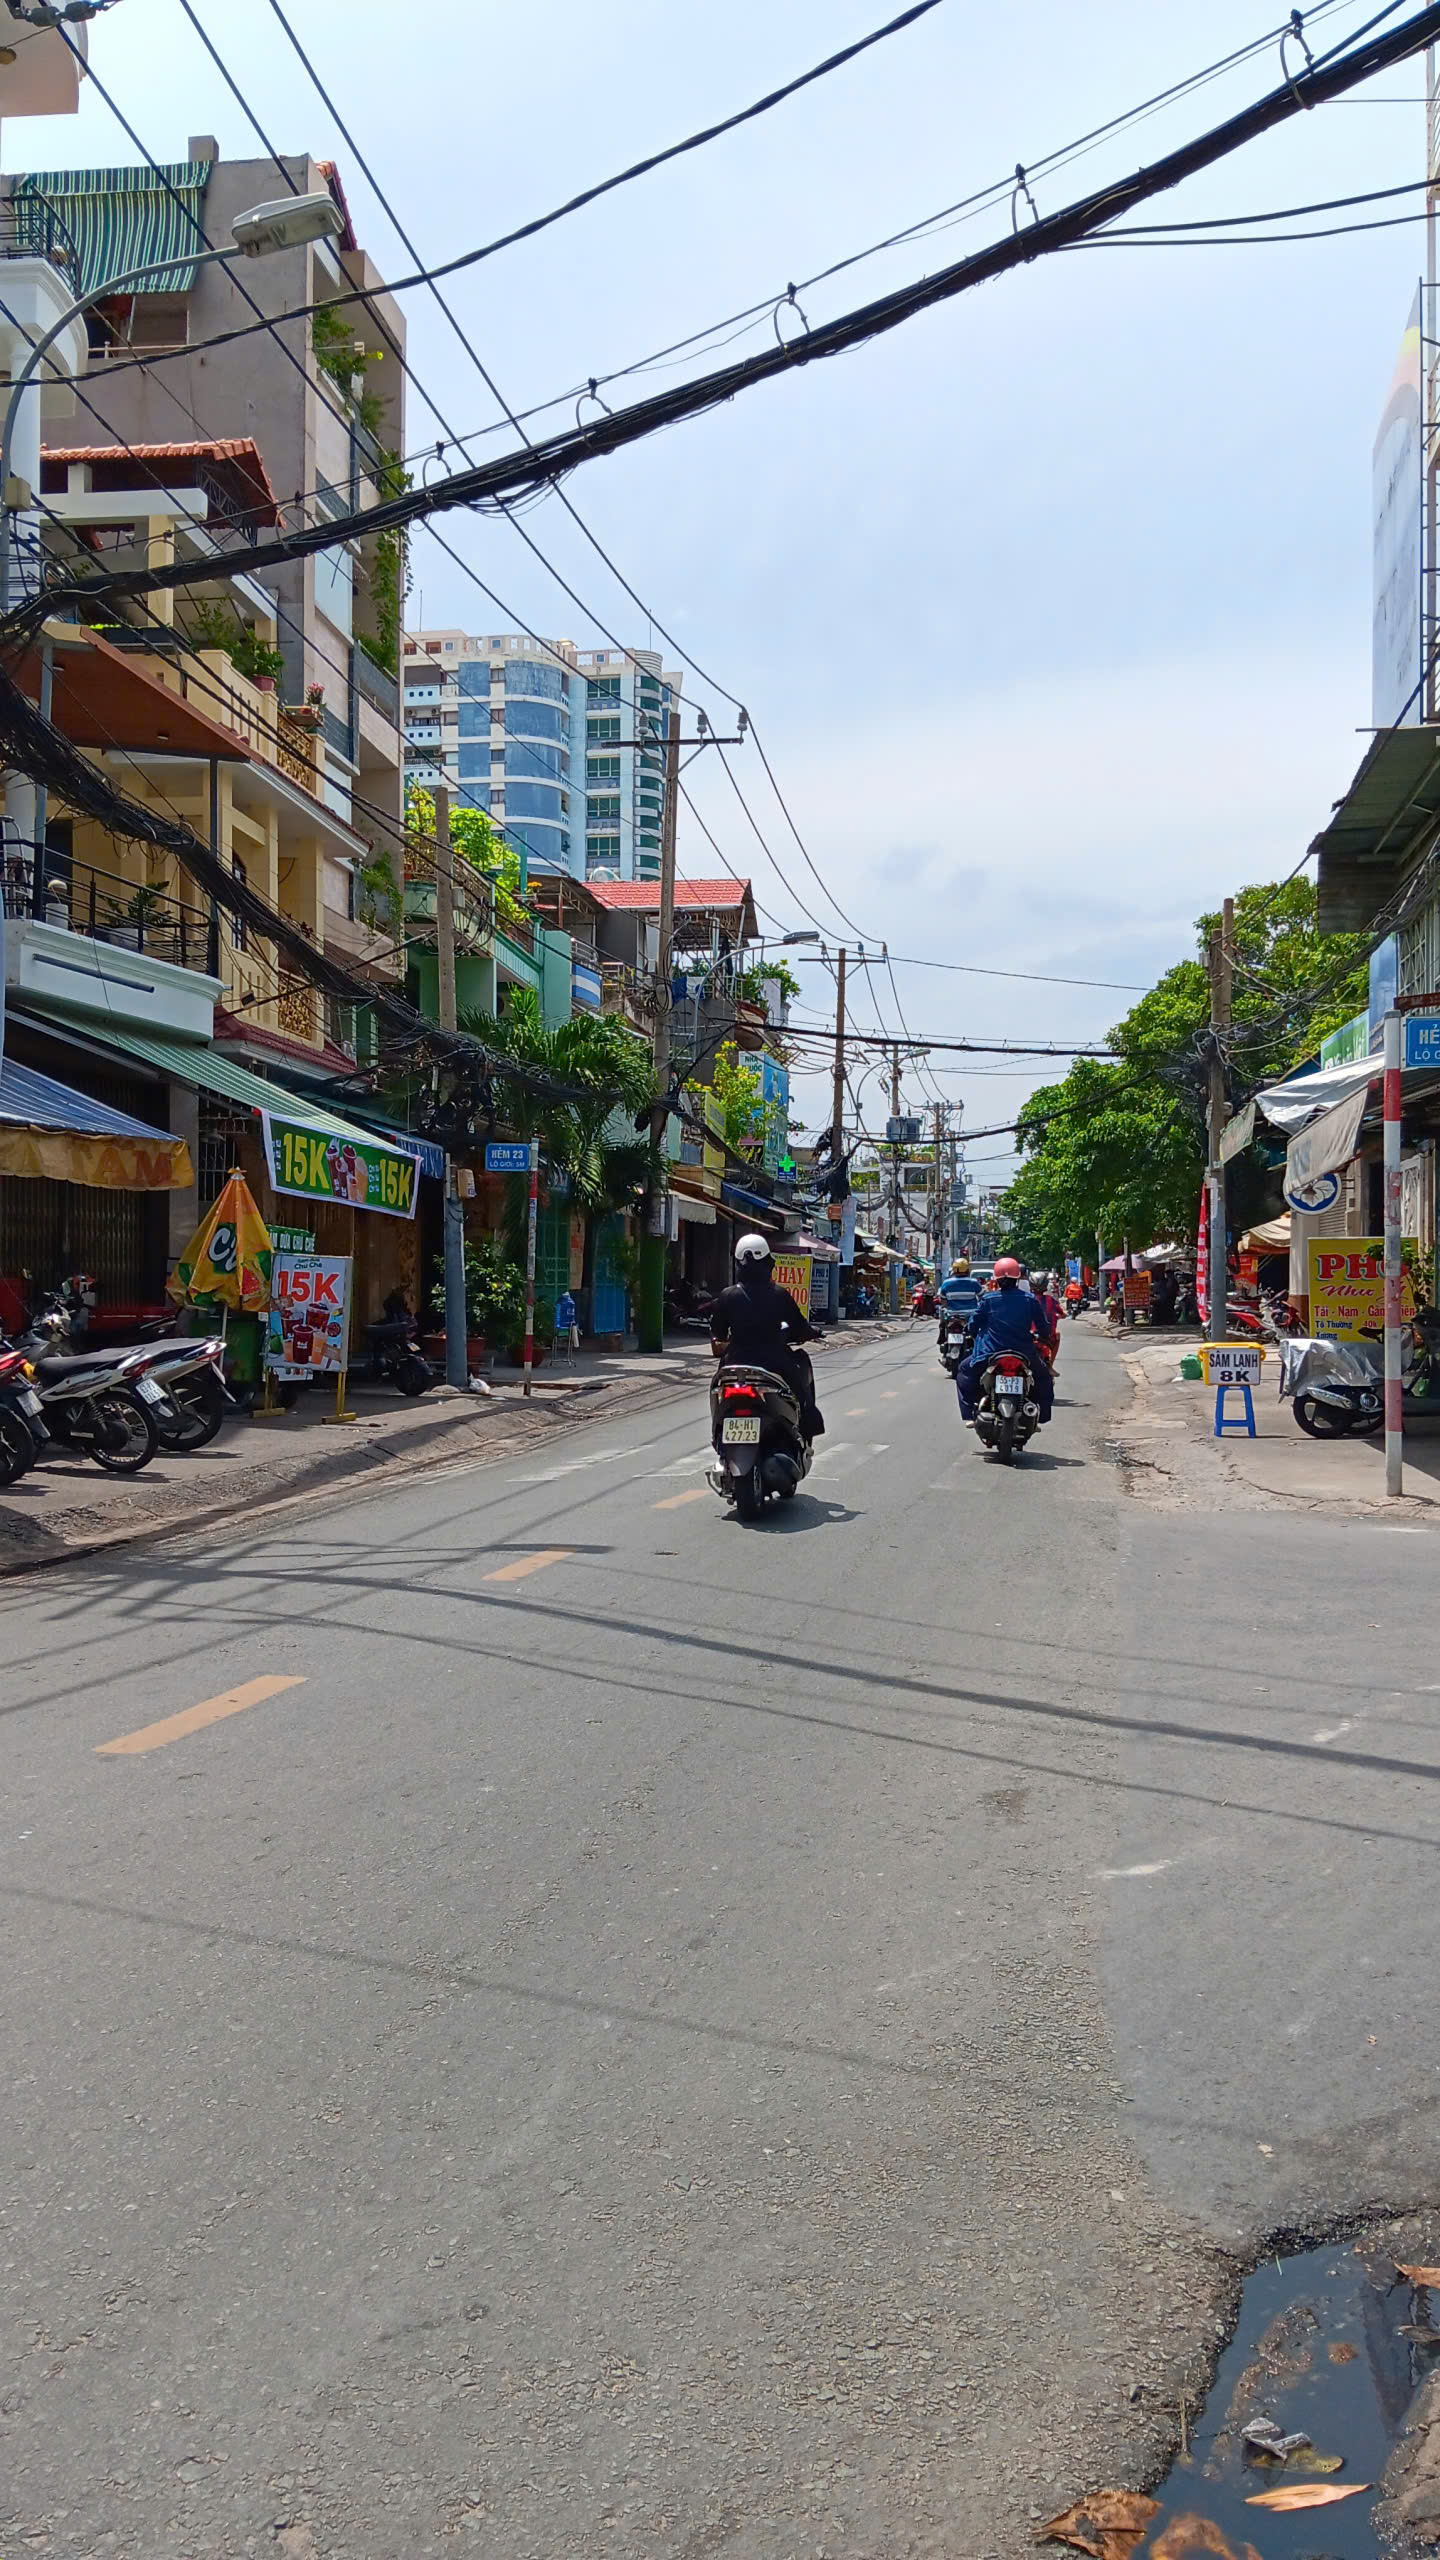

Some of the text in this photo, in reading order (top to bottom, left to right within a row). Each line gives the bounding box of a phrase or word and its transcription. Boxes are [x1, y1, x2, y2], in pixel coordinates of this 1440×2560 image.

[512, 1150, 523, 1159] 23
[283, 1133, 330, 1189] 15K
[380, 1159, 413, 1208] 15K
[278, 1271, 339, 1304] 15K
[1209, 1350, 1258, 1370] SÂM LẠNH
[1220, 1370, 1250, 1382] 8K
[728, 1419, 754, 1431] 84-H1
[724, 1431, 758, 1442] 427.23
